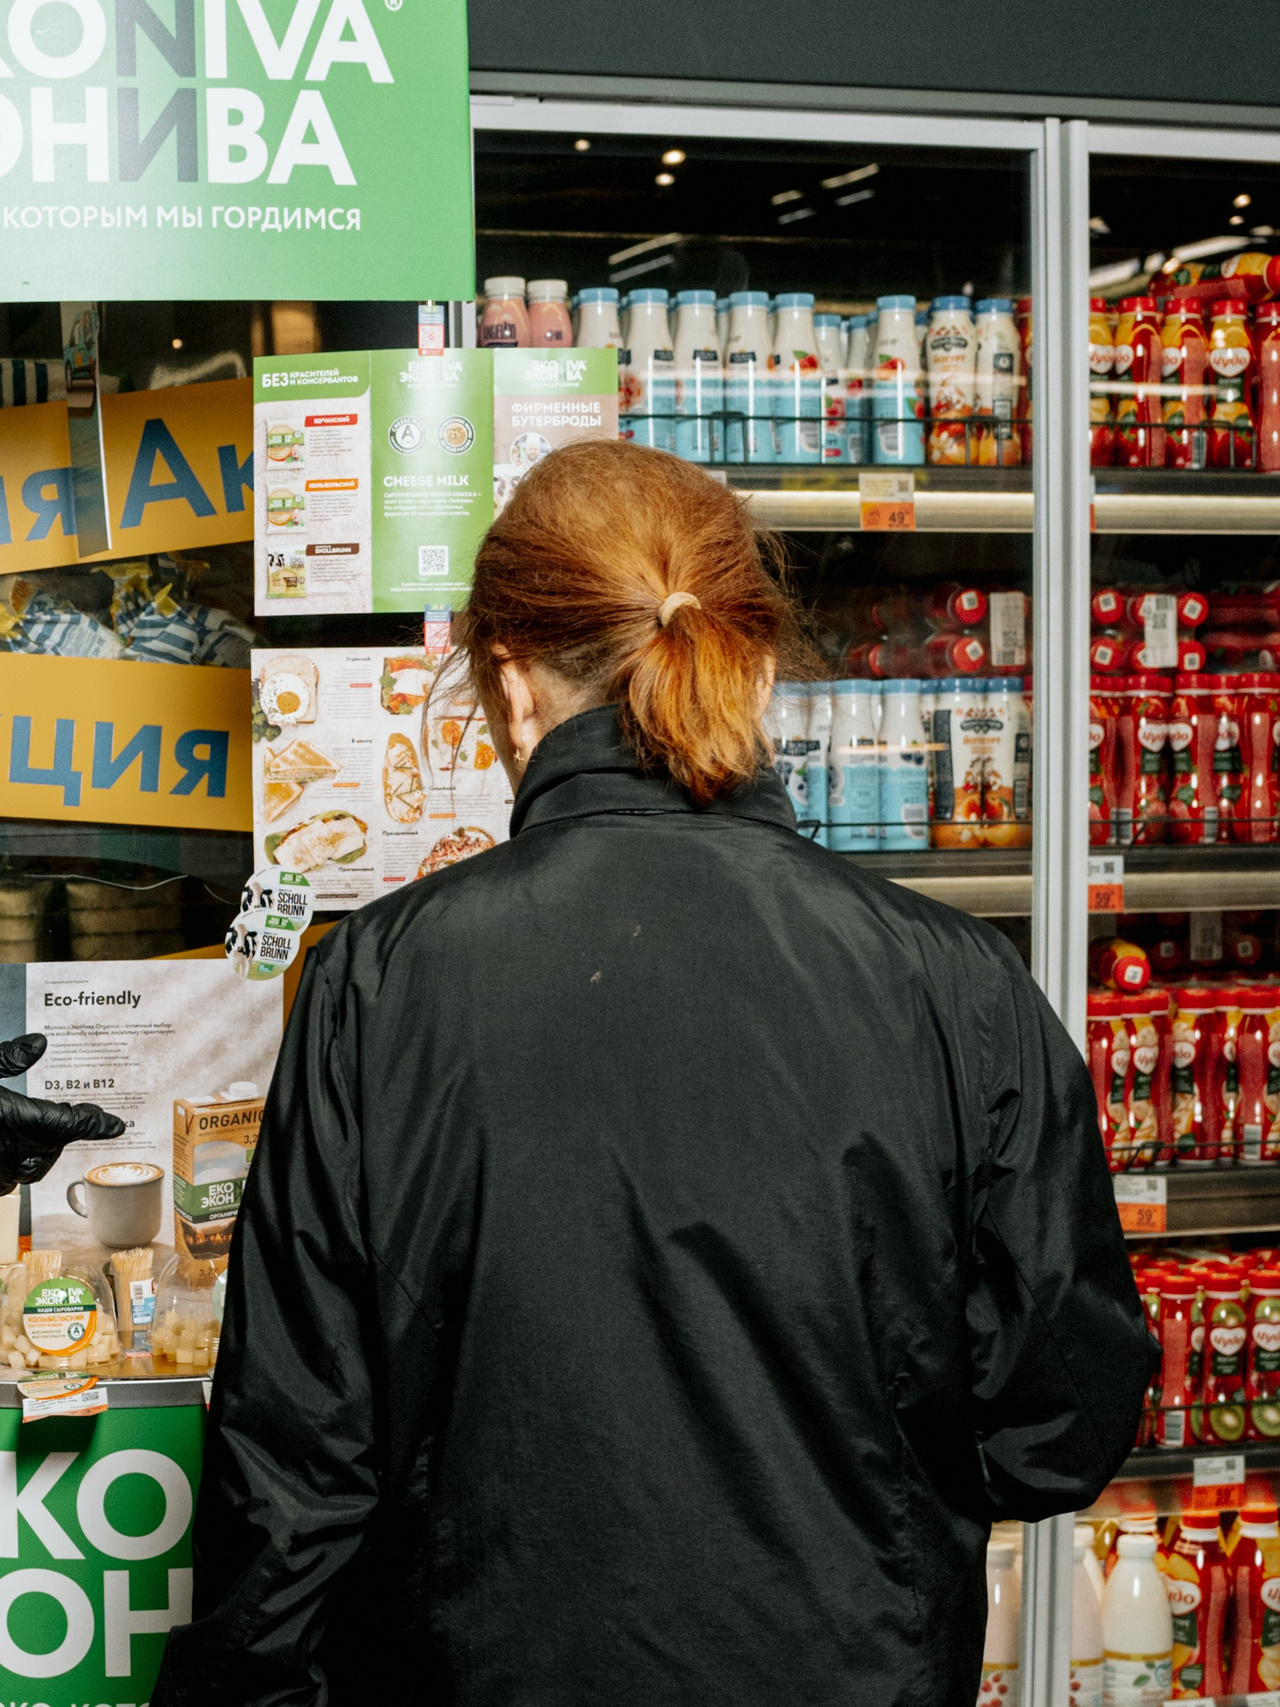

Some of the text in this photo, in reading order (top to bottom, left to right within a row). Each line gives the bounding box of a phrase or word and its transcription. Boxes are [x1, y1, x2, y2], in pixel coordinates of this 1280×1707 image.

[3, 206, 148, 230] КОТОРЫМ
[157, 206, 204, 230] МЫ
[211, 207, 361, 233] ГОРДИМСЯ
[262, 368, 340, 388] БЕЗ КРАСИТЕЛЕЙ
[297, 375, 359, 385] КОНСЕРВАНТОВ
[511, 402, 601, 414] ФИРМЕННЫЕ
[511, 415, 602, 428] БУТЕРБРОДЫ
[383, 475, 470, 487] CHEESE MILK
[277, 891, 308, 905] SCHOLL
[277, 904, 306, 916] BRUNN
[261, 934, 292, 949] SCHOLL
[260, 946, 289, 960] BRUNN
[44, 990, 141, 1008] Eco-friendly
[45, 1080, 64, 1091] D3,
[66, 1079, 81, 1089] B2
[93, 1078, 115, 1088] B12
[209, 1211, 239, 1221] ОРГАНИЧЕ
[27, 1314, 84, 1323] КОЛЫБЕЛЬСКИЙ
